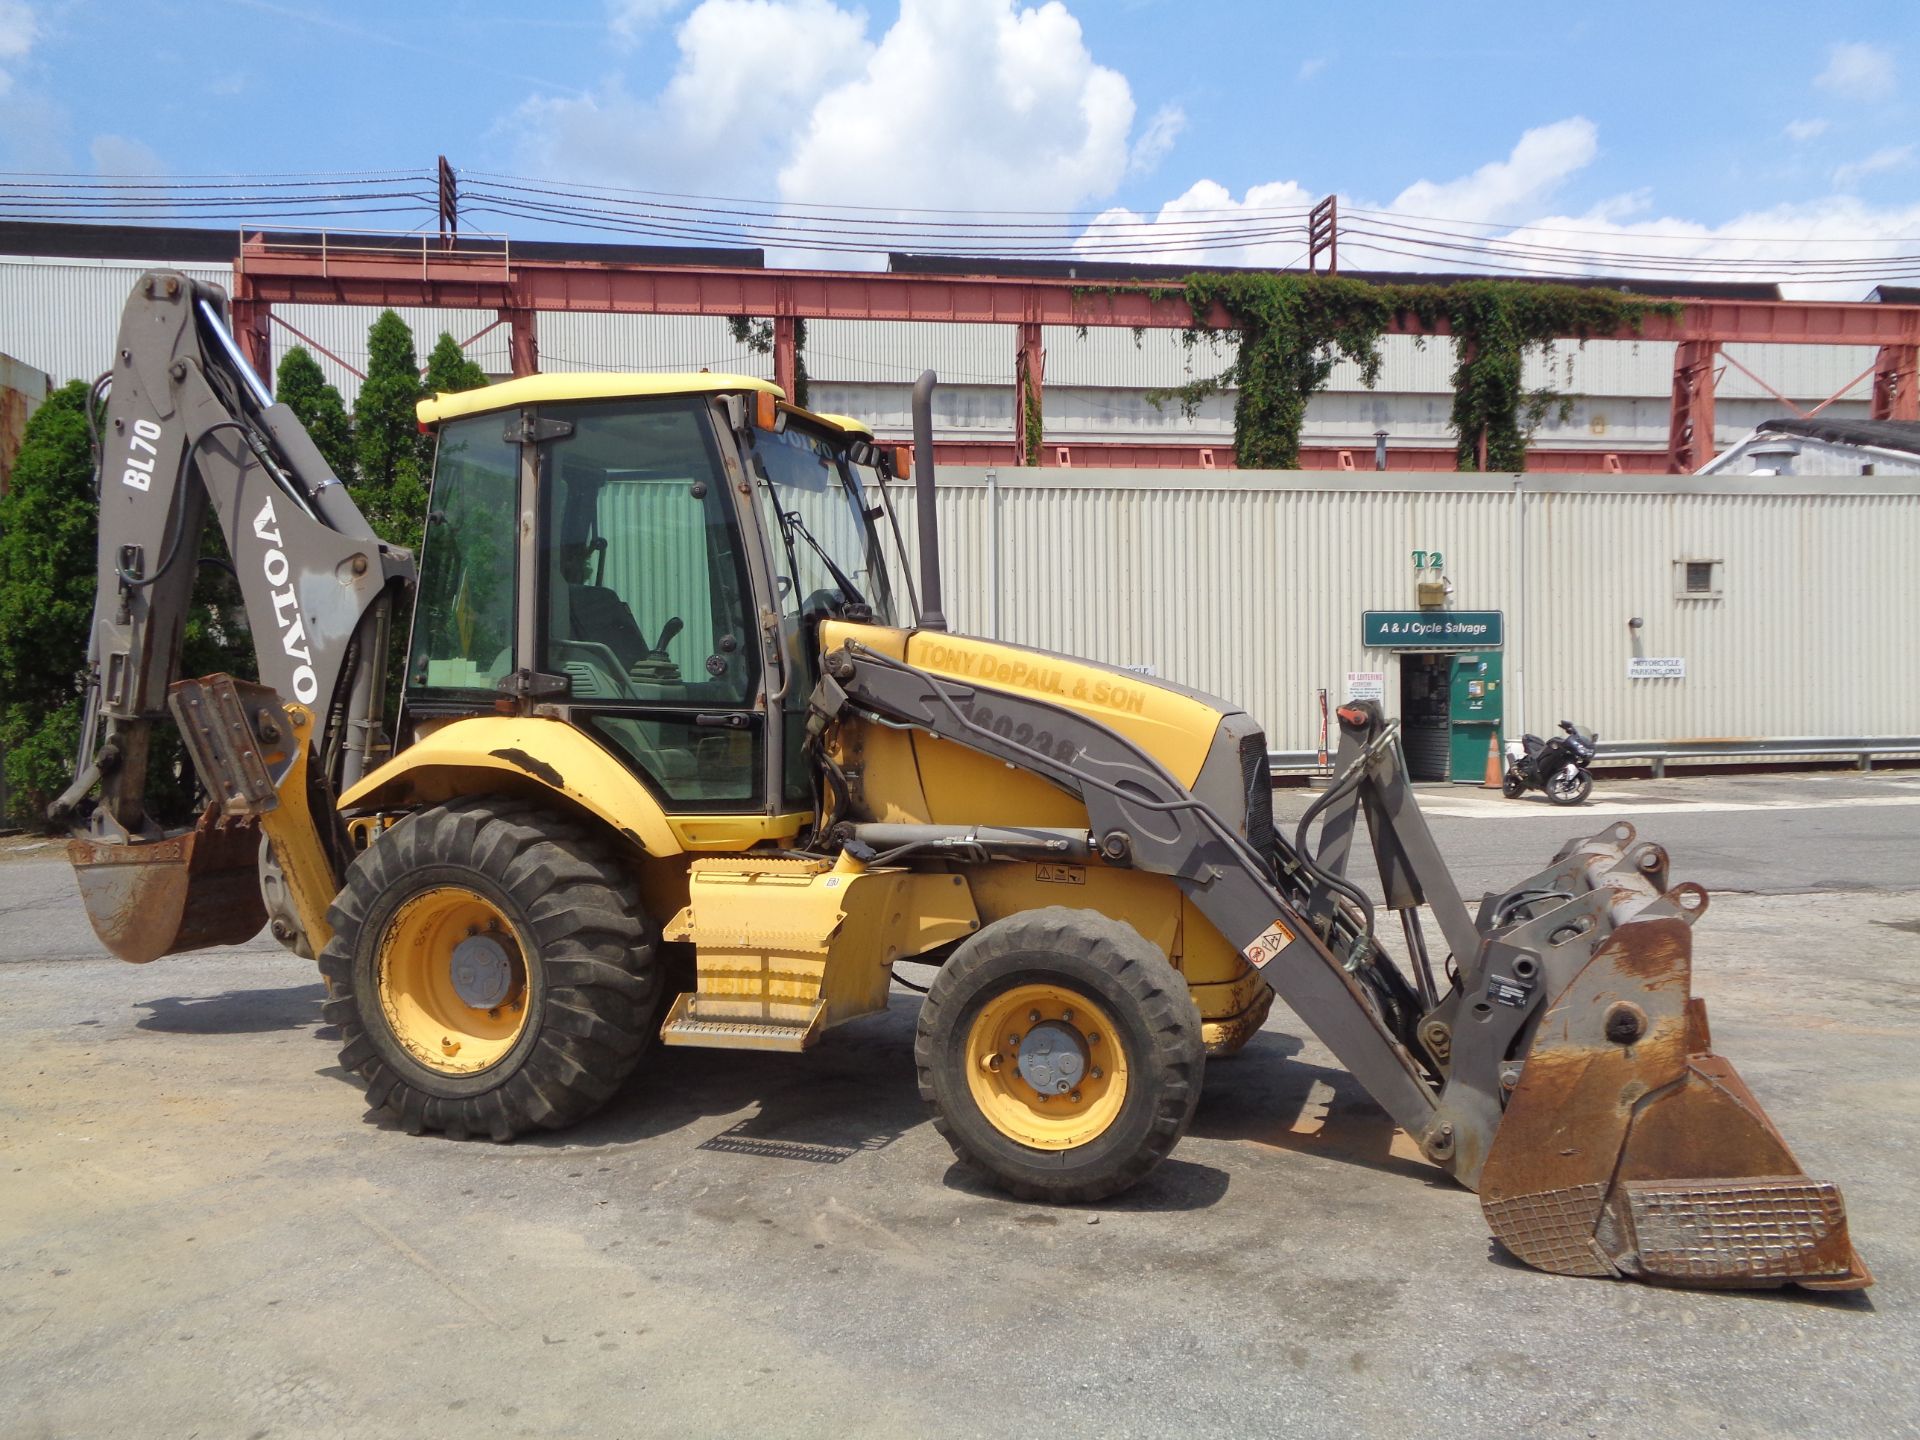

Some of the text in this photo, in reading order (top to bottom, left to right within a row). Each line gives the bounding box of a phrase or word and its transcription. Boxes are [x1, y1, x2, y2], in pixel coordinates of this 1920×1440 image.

[122, 419, 162, 492] BL70
[253, 495, 318, 704] VOLVO
[1380, 622, 1487, 635] A & J Cycle Salvage
[918, 640, 1148, 714] TONY DePAUL & SON
